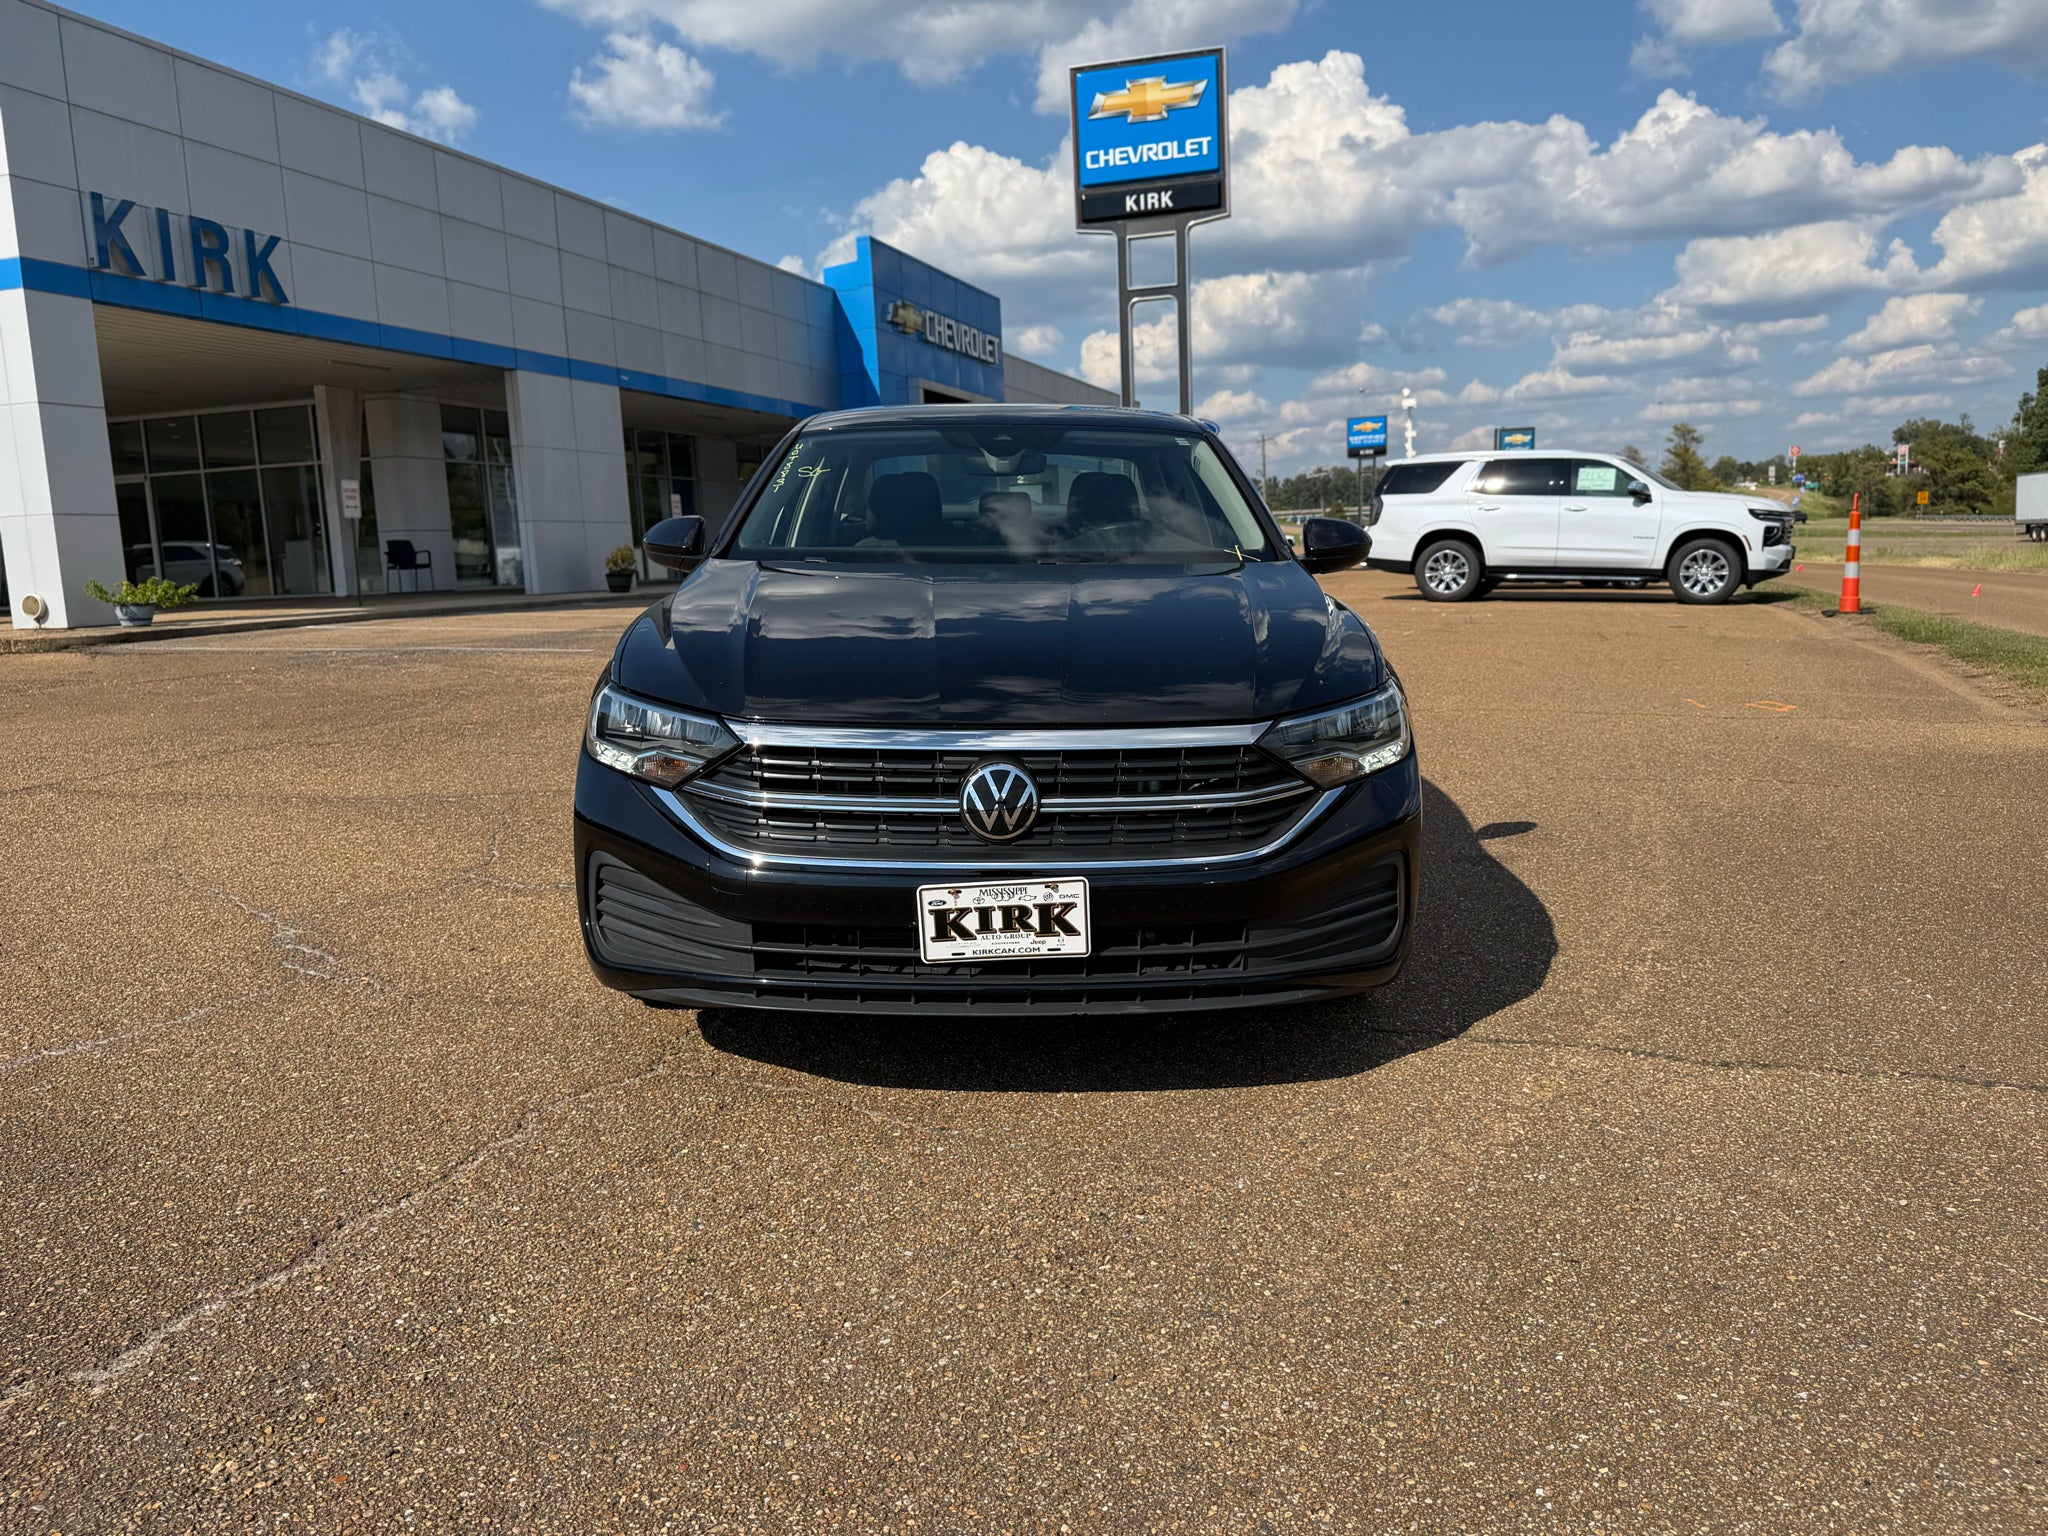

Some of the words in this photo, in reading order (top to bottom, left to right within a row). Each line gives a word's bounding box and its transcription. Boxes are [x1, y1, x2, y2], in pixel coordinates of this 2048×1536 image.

[1085, 136, 1212, 169] CHEVROLET
[1125, 190, 1174, 212] KIRK
[89, 191, 290, 304] KIRK
[925, 309, 1000, 365] CHEVROLET
[978, 886, 1028, 902] MISSISSIPPI
[928, 901, 1081, 943] KIRK
[972, 947, 1041, 956] KIRKCAN.COM
